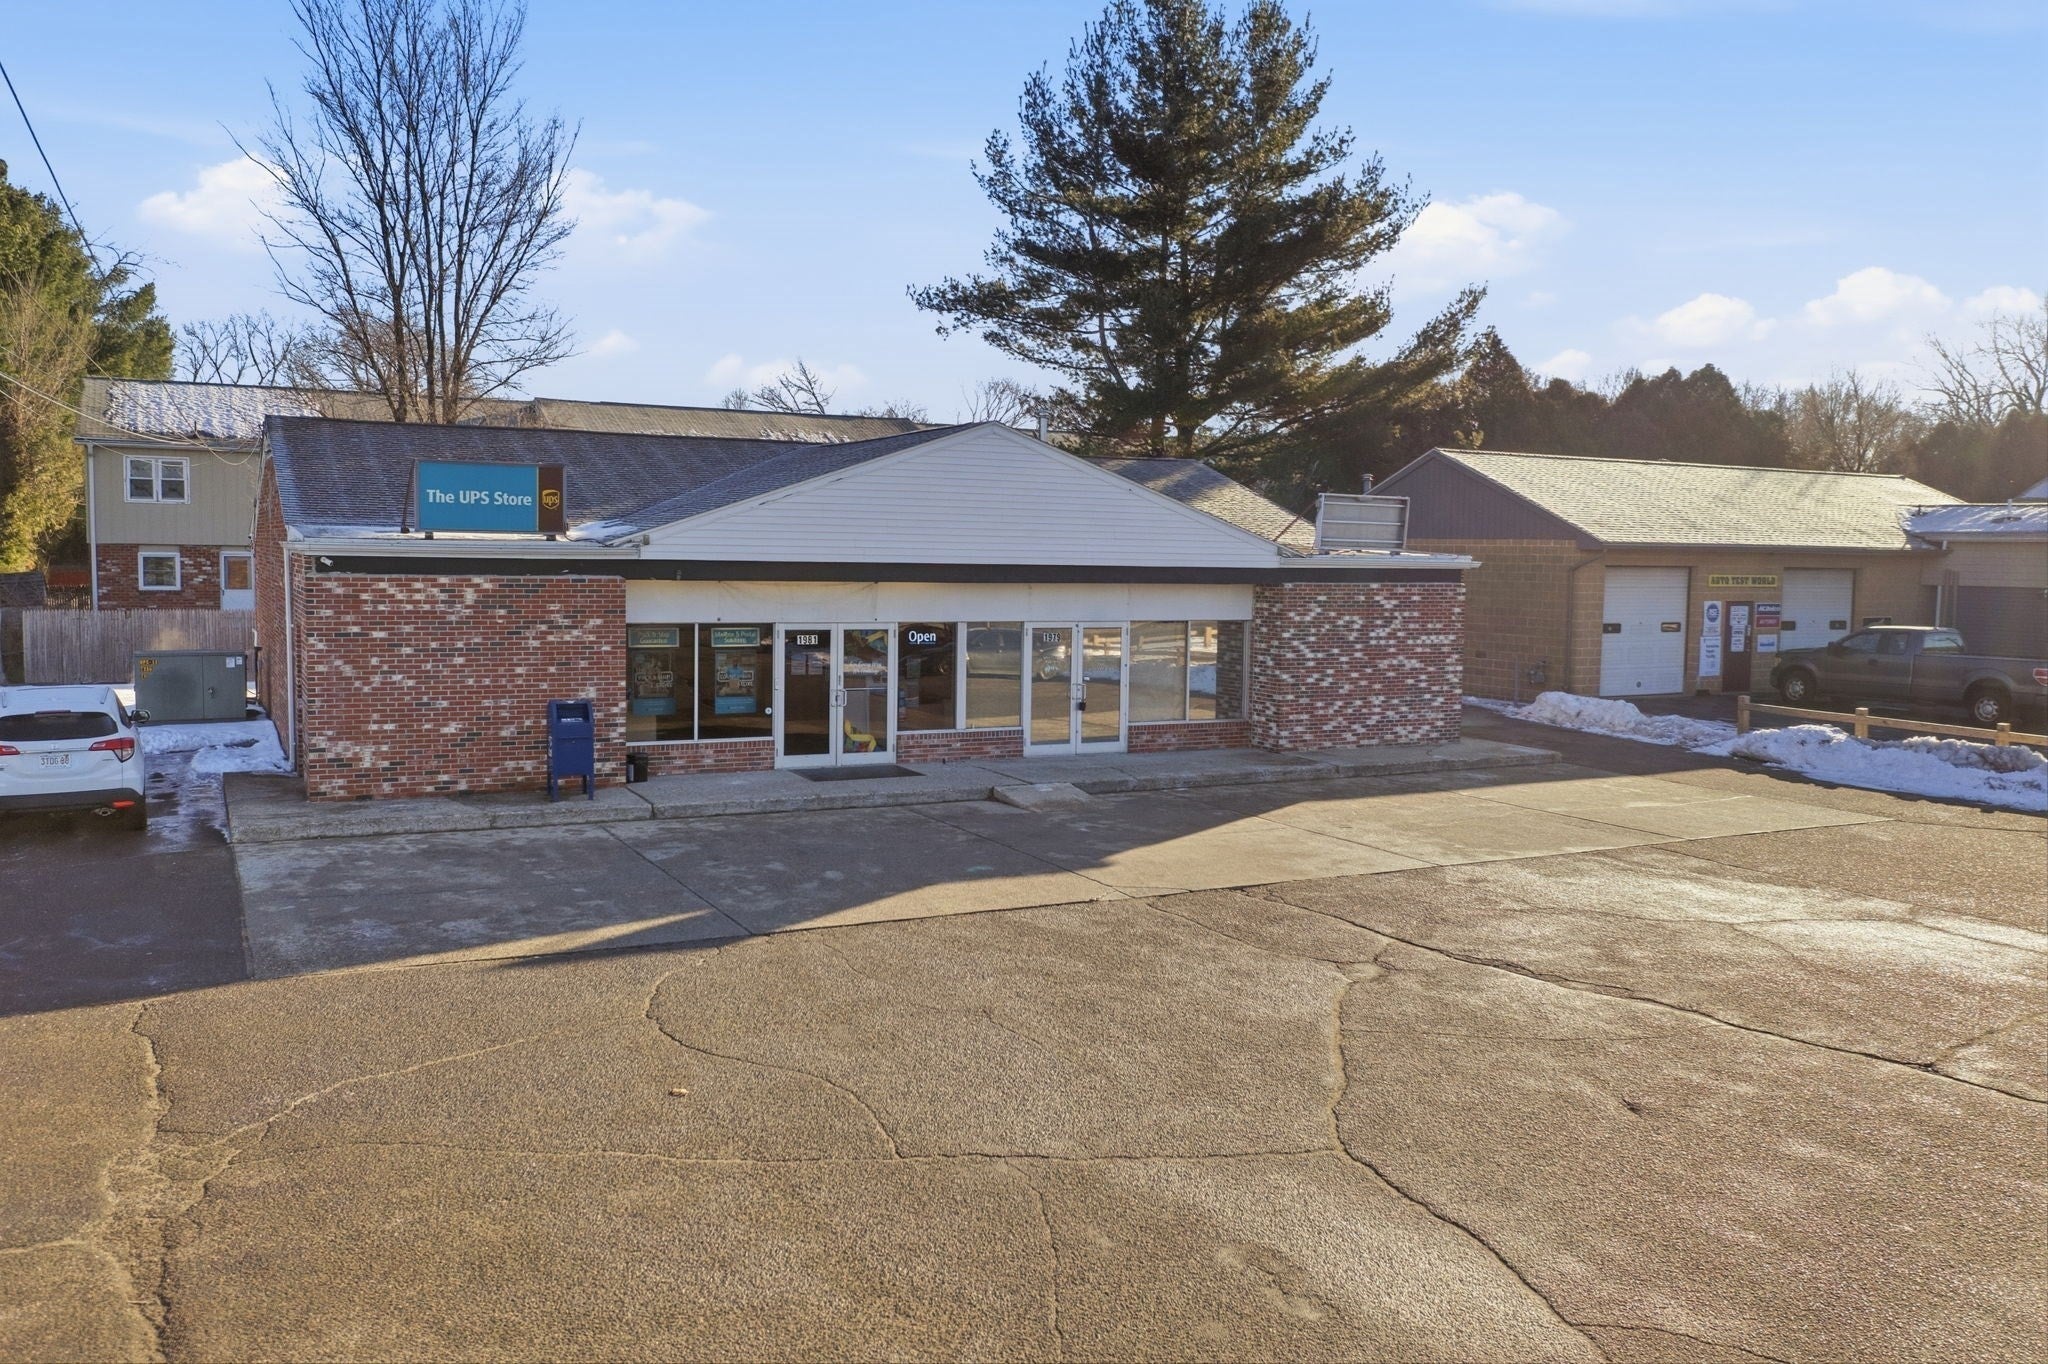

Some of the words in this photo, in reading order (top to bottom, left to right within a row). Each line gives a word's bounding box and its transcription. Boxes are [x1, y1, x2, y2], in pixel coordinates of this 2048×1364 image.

[426, 489, 455, 504] The
[459, 490, 490, 505] UPS
[493, 491, 532, 506] Store
[543, 494, 559, 507] ups
[1711, 576, 1729, 585] AUTO
[1731, 576, 1750, 585] TEST
[1751, 576, 1776, 585] WORLD
[798, 635, 817, 645] 1981
[908, 630, 936, 644] Open
[1043, 632, 1061, 642] 1979
